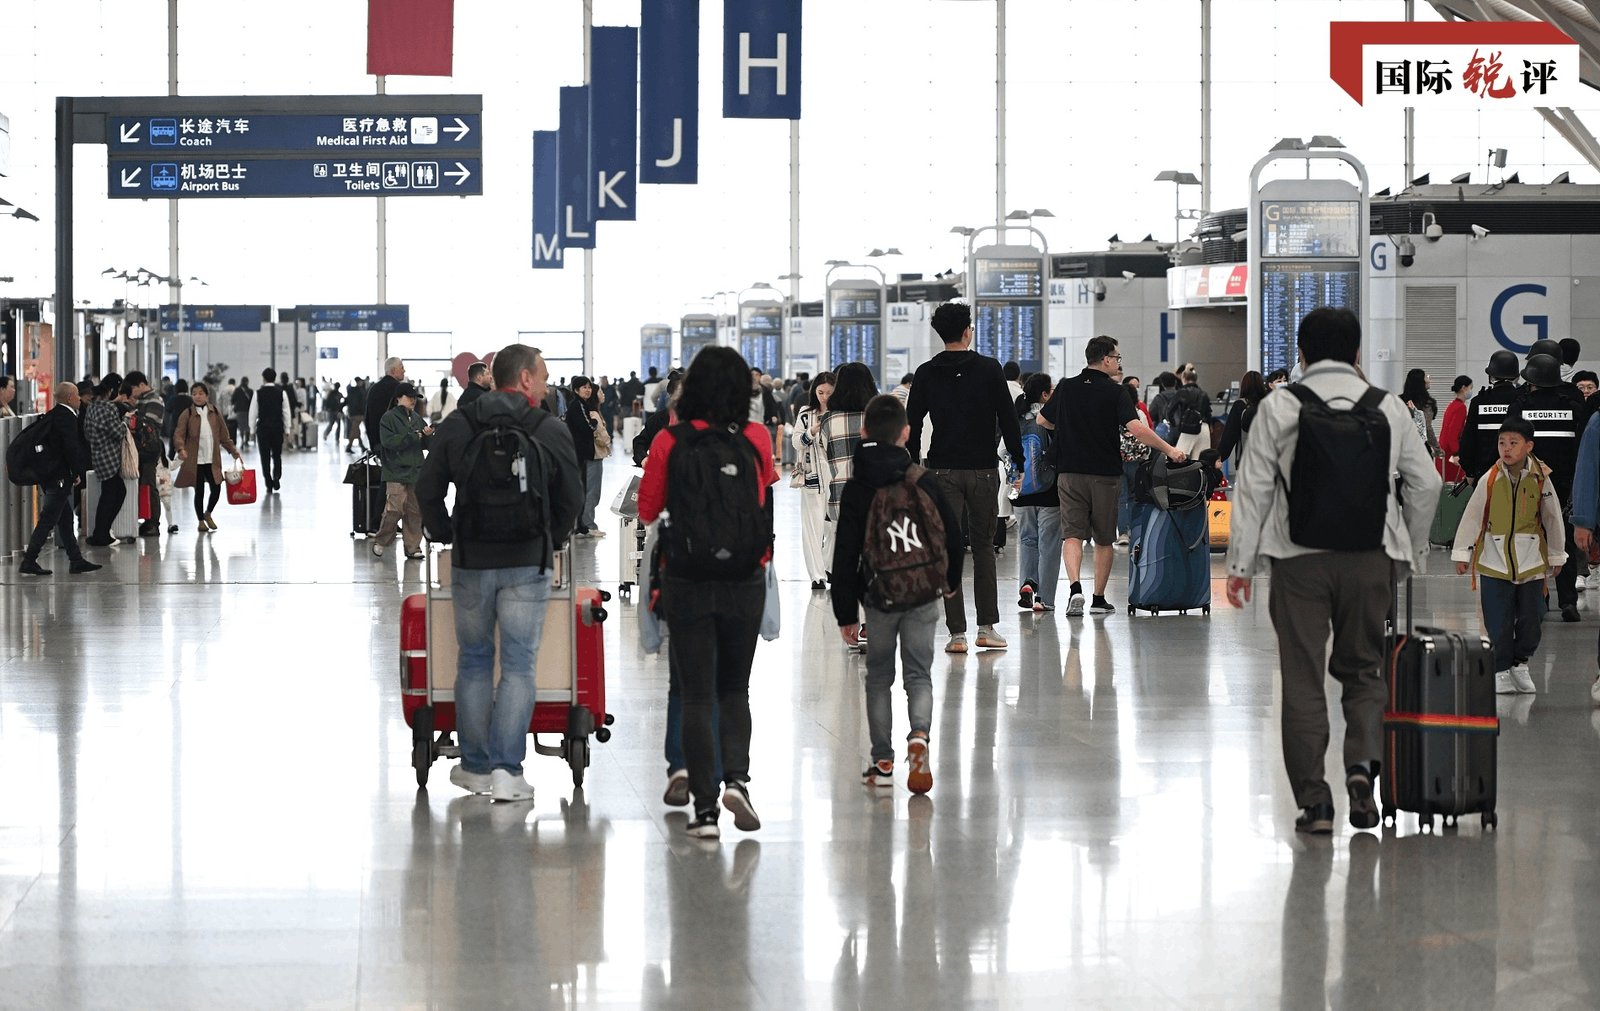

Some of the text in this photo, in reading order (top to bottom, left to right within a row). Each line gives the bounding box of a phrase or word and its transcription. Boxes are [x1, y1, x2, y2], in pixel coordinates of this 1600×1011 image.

[739, 32, 787, 95] H
[180, 118, 249, 134] 长途汽车
[343, 117, 407, 133] 医疗急救
[180, 137, 212, 146] Coach
[316, 135, 408, 146] Medical First Aid
[656, 118, 682, 167] J
[180, 163, 247, 180] 机场巴士
[332, 163, 380, 177] 卫生间
[180, 181, 240, 193] Airport Bus
[345, 180, 381, 190] Toilets
[598, 171, 627, 208] K
[566, 205, 589, 238] L
[1265, 204, 1280, 221] G
[534, 233, 561, 261] M
[1370, 242, 1387, 271] G
[1078, 283, 1088, 304] H
[1490, 283, 1549, 354] G
[886, 516, 923, 553] NY
